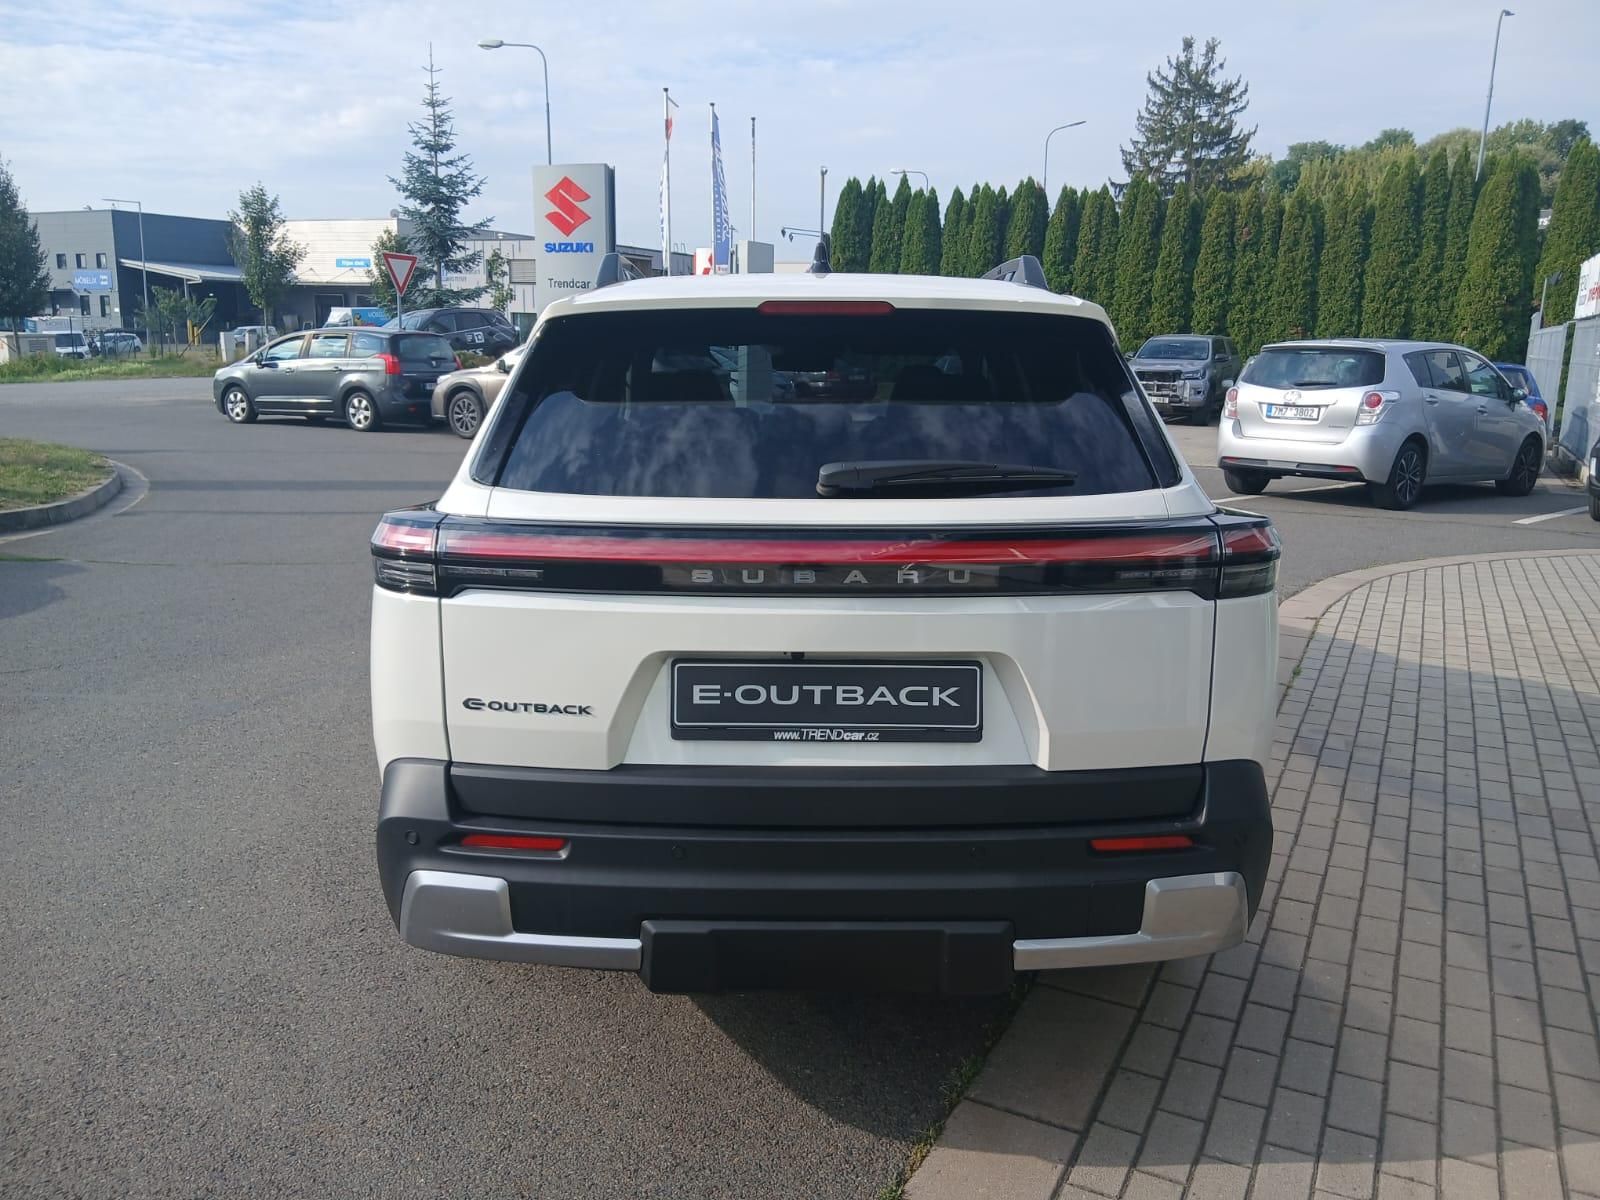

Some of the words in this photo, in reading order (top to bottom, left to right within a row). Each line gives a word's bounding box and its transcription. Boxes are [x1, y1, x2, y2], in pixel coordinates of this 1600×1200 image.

[544, 242, 594, 253] SUZUKI
[547, 278, 591, 289] Trendcar
[691, 569, 970, 584] SUBARU
[692, 684, 961, 707] E-OUTBACK
[773, 728, 880, 741] www.TRENDcar.cz
